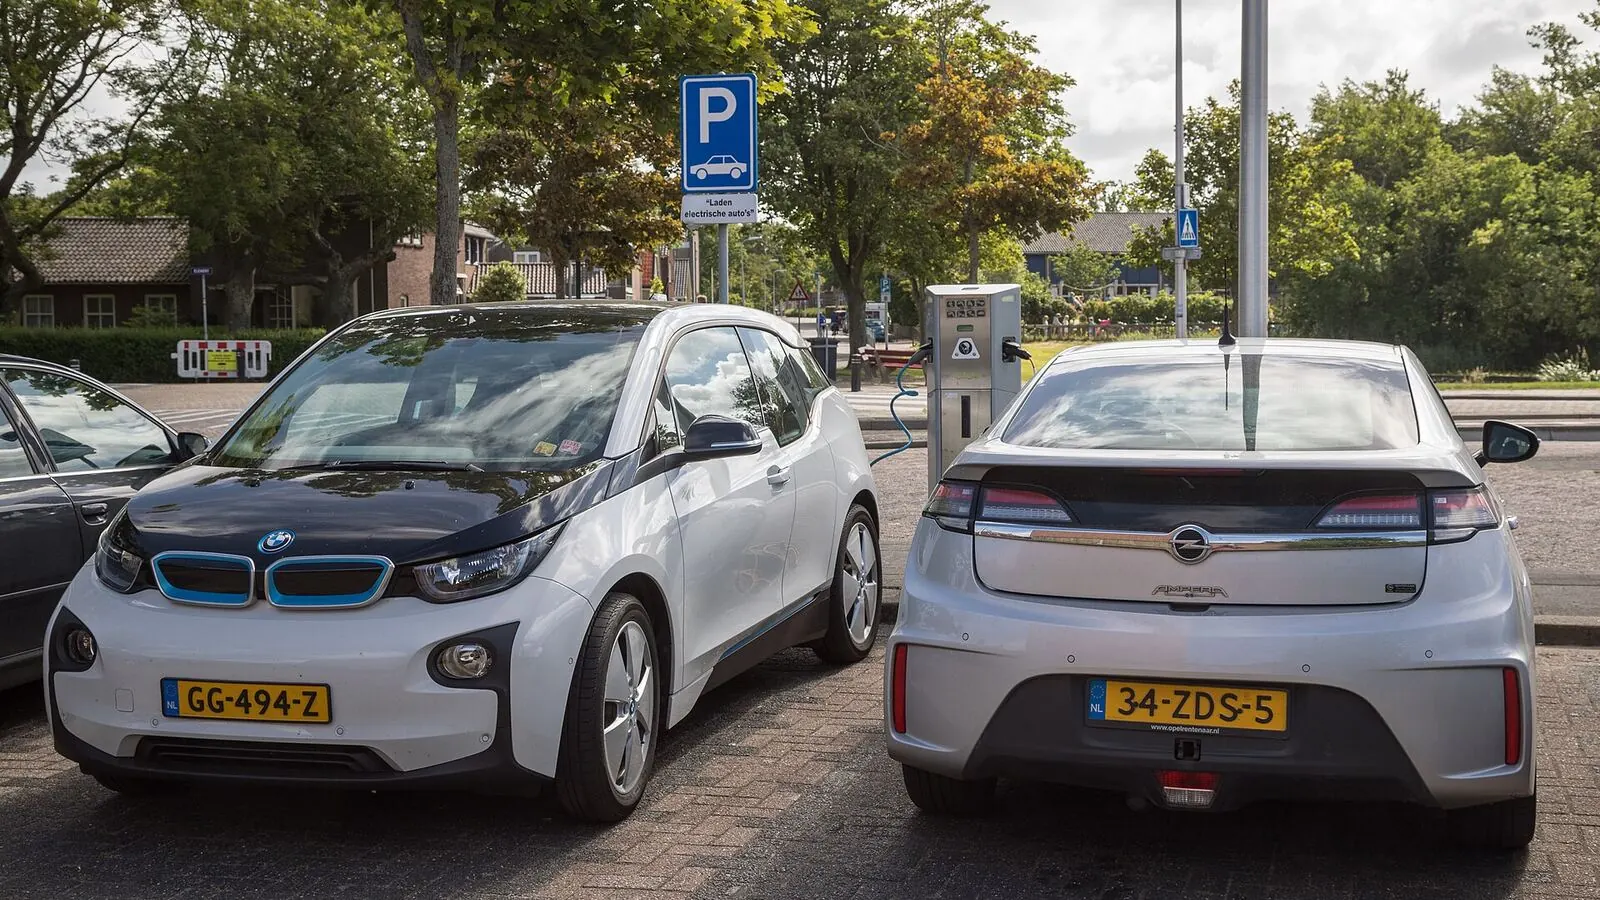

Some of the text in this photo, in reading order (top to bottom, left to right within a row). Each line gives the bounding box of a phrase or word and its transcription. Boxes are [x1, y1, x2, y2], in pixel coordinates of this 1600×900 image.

[699, 87, 737, 143] P
[684, 210, 726, 218] electrische
[1152, 585, 1229, 598] AMPERA
[167, 686, 319, 717] NL GG-494-Z
[1090, 686, 1274, 724] NL 34-ZDS-5
